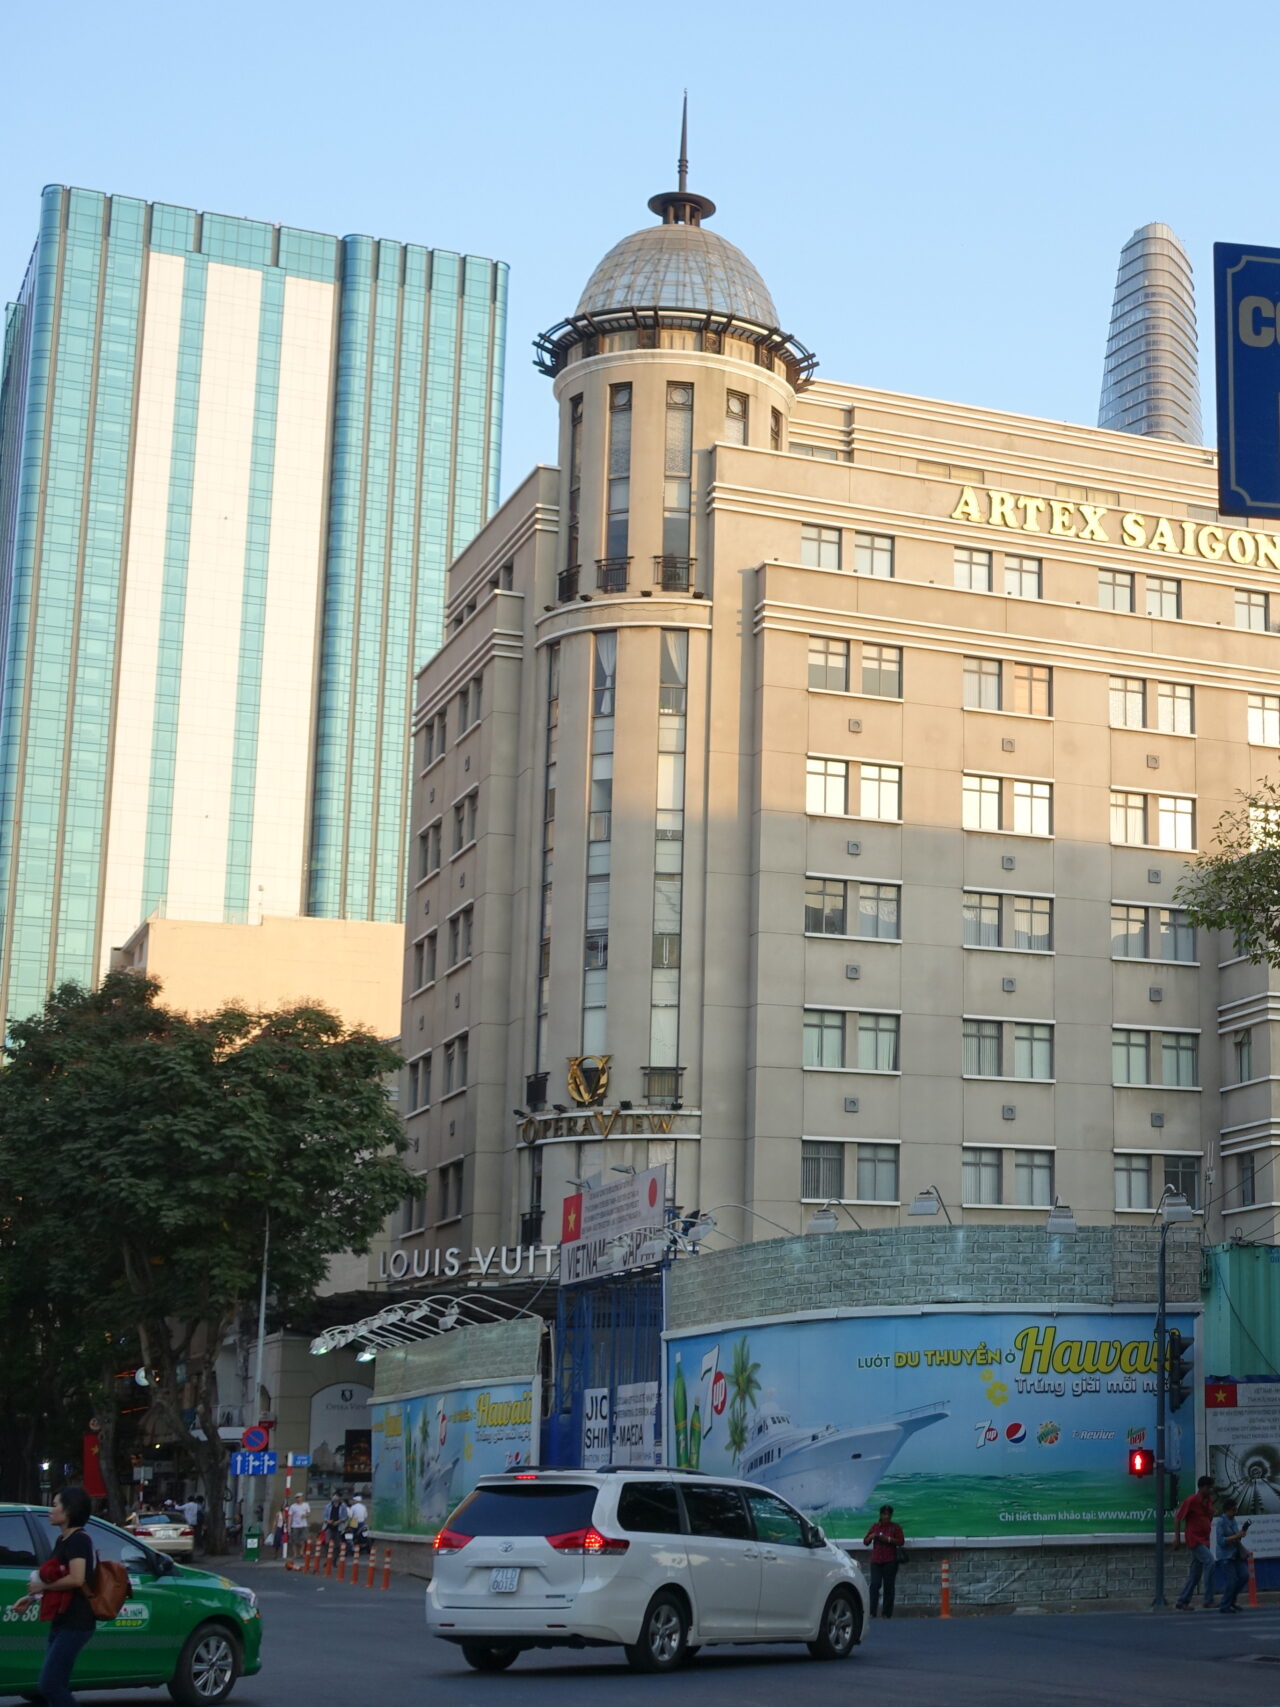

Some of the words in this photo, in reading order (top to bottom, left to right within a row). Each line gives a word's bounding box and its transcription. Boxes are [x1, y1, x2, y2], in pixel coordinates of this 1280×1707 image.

[951, 485, 1110, 542] ARTEX
[522, 1116, 595, 1144] OPERA
[594, 1109, 676, 1139] VIEW
[379, 1247, 462, 1278] LOUIS
[475, 1245, 558, 1277] VUIT
[893, 1351, 919, 1368] DU
[924, 1341, 1001, 1367] THUYỀN
[1015, 1377, 1065, 1396] Trúng
[1072, 1375, 1100, 1396] giải
[1106, 1375, 1137, 1393] mỗi
[1032, 1510, 1057, 1521] tham
[1058, 1508, 1081, 1521] khảo
